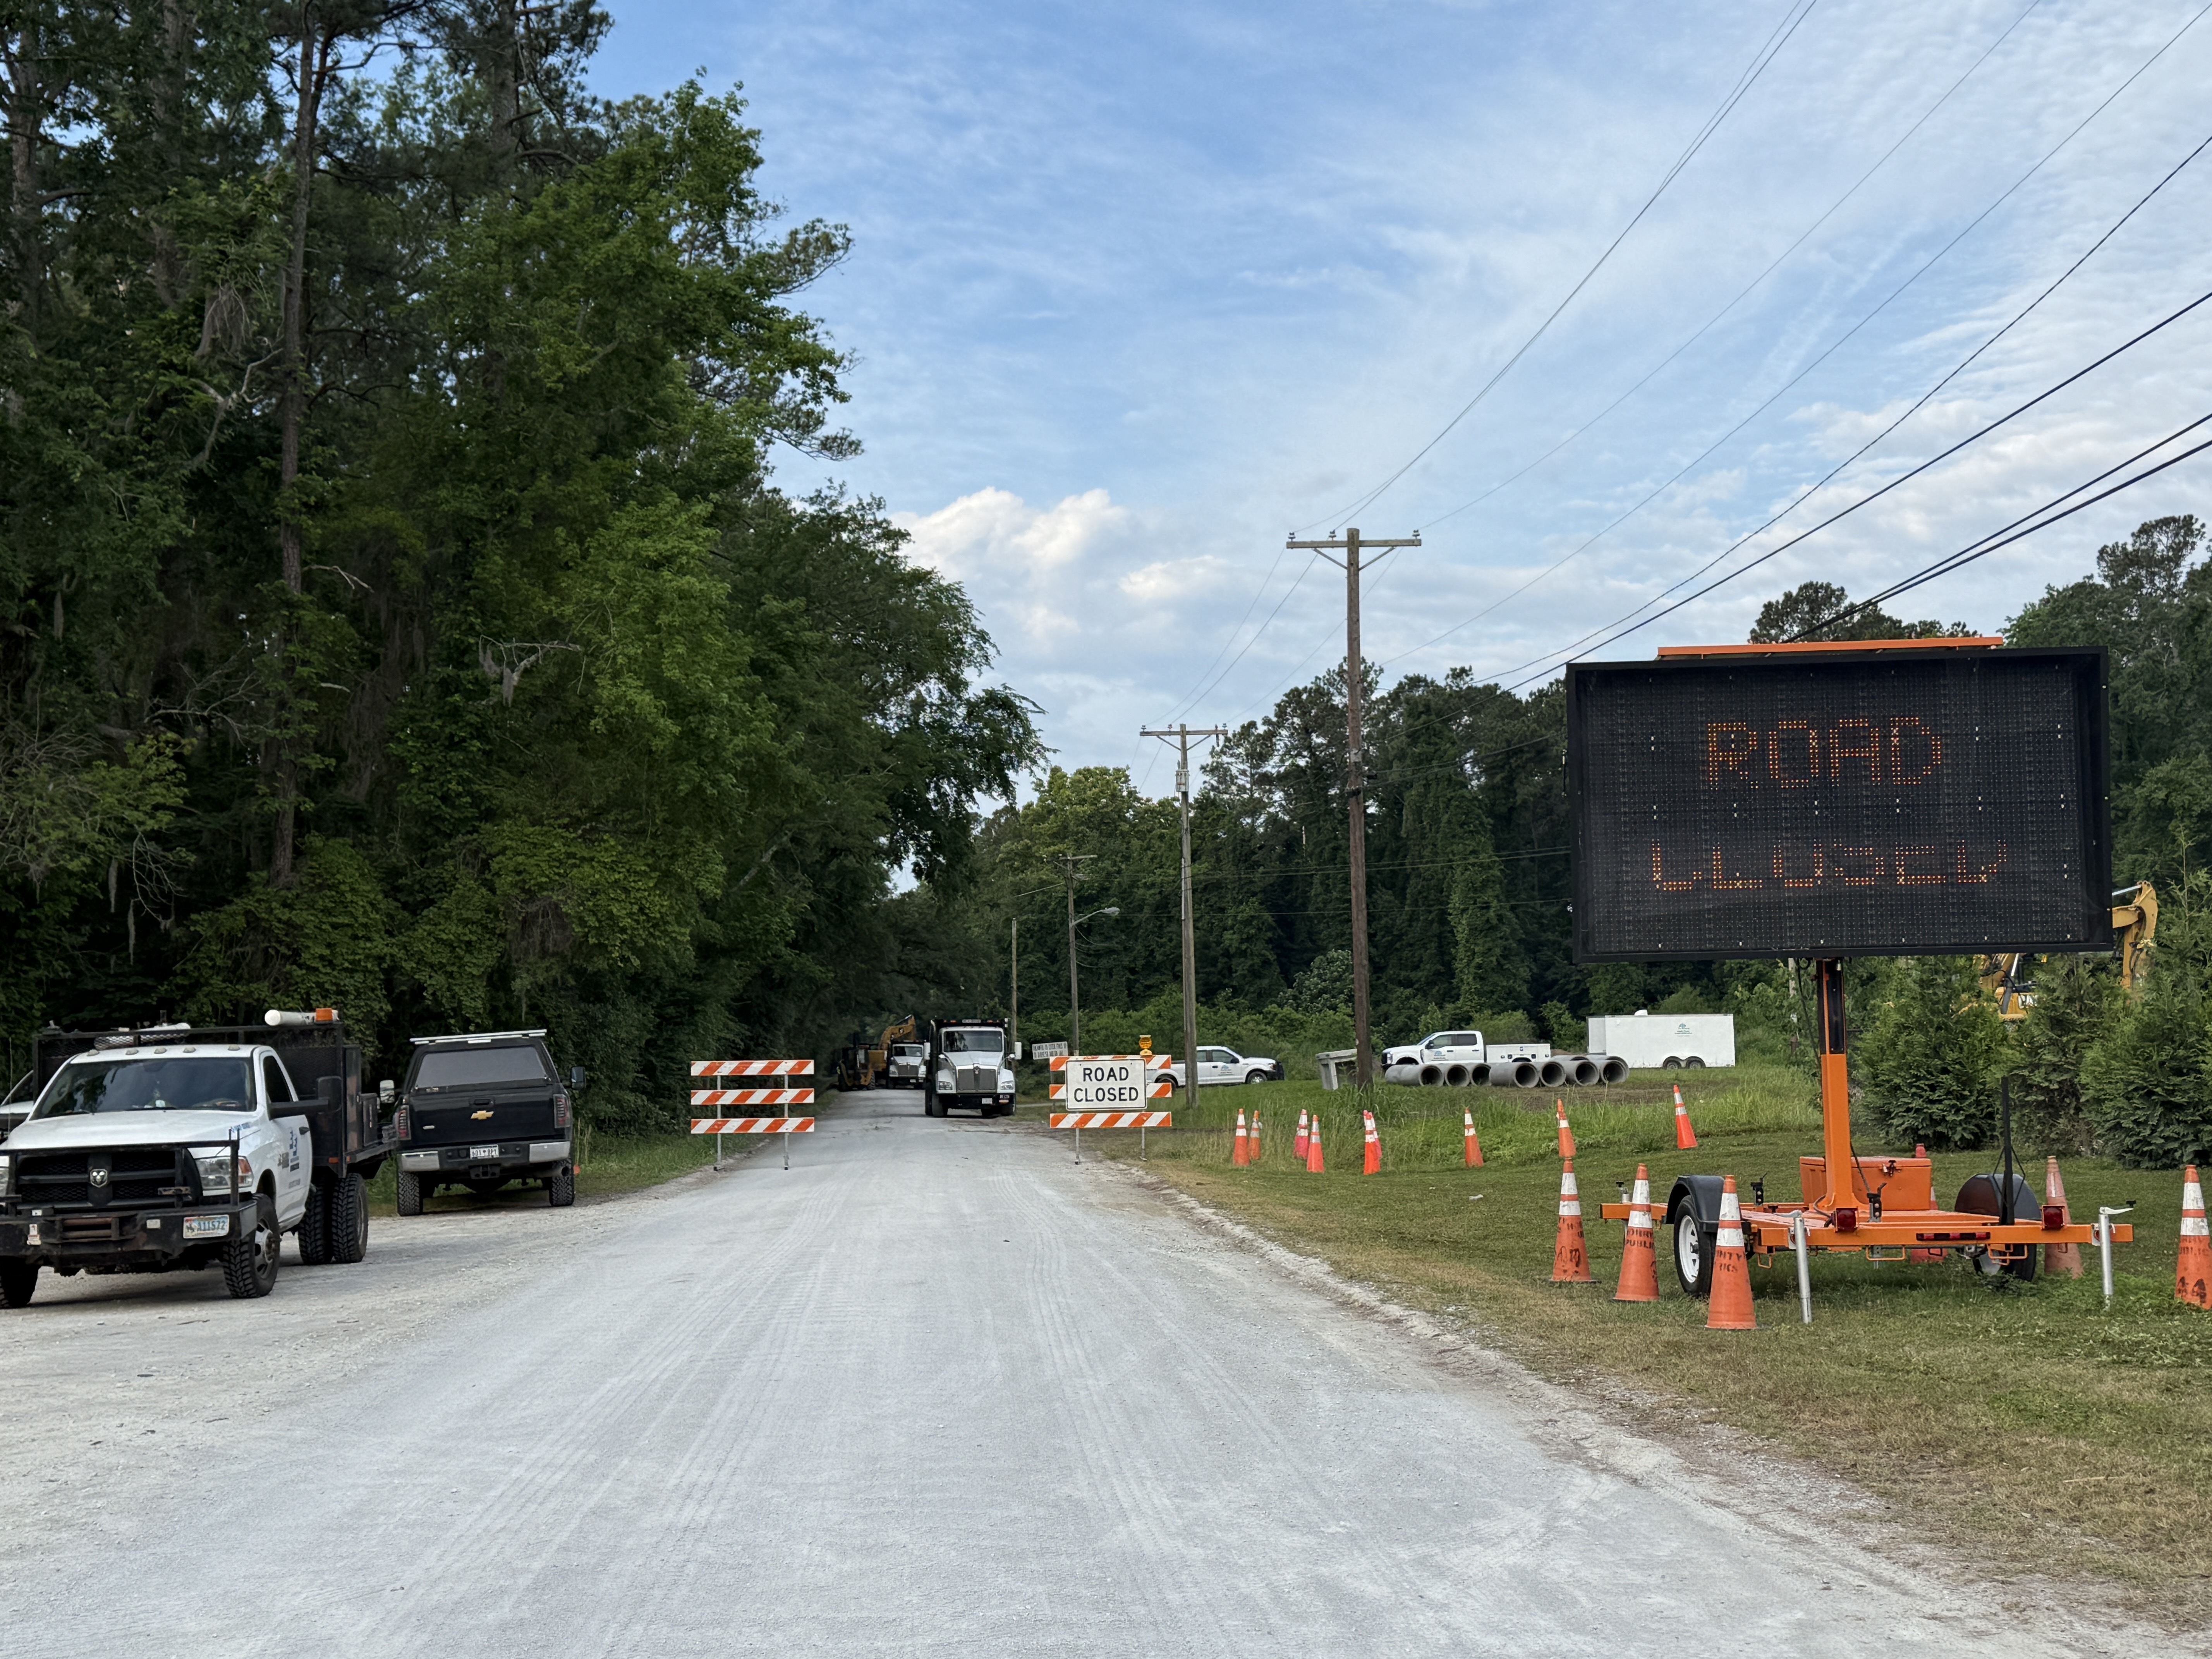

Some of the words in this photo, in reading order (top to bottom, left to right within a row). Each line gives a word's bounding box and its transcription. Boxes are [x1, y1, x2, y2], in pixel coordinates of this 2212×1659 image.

[1707, 716, 1941, 790] ROAD
[2018, 994, 2038, 1009] CA
[1083, 1066, 1129, 1082] ROAD
[1074, 1087, 1139, 1103] CLOSED
